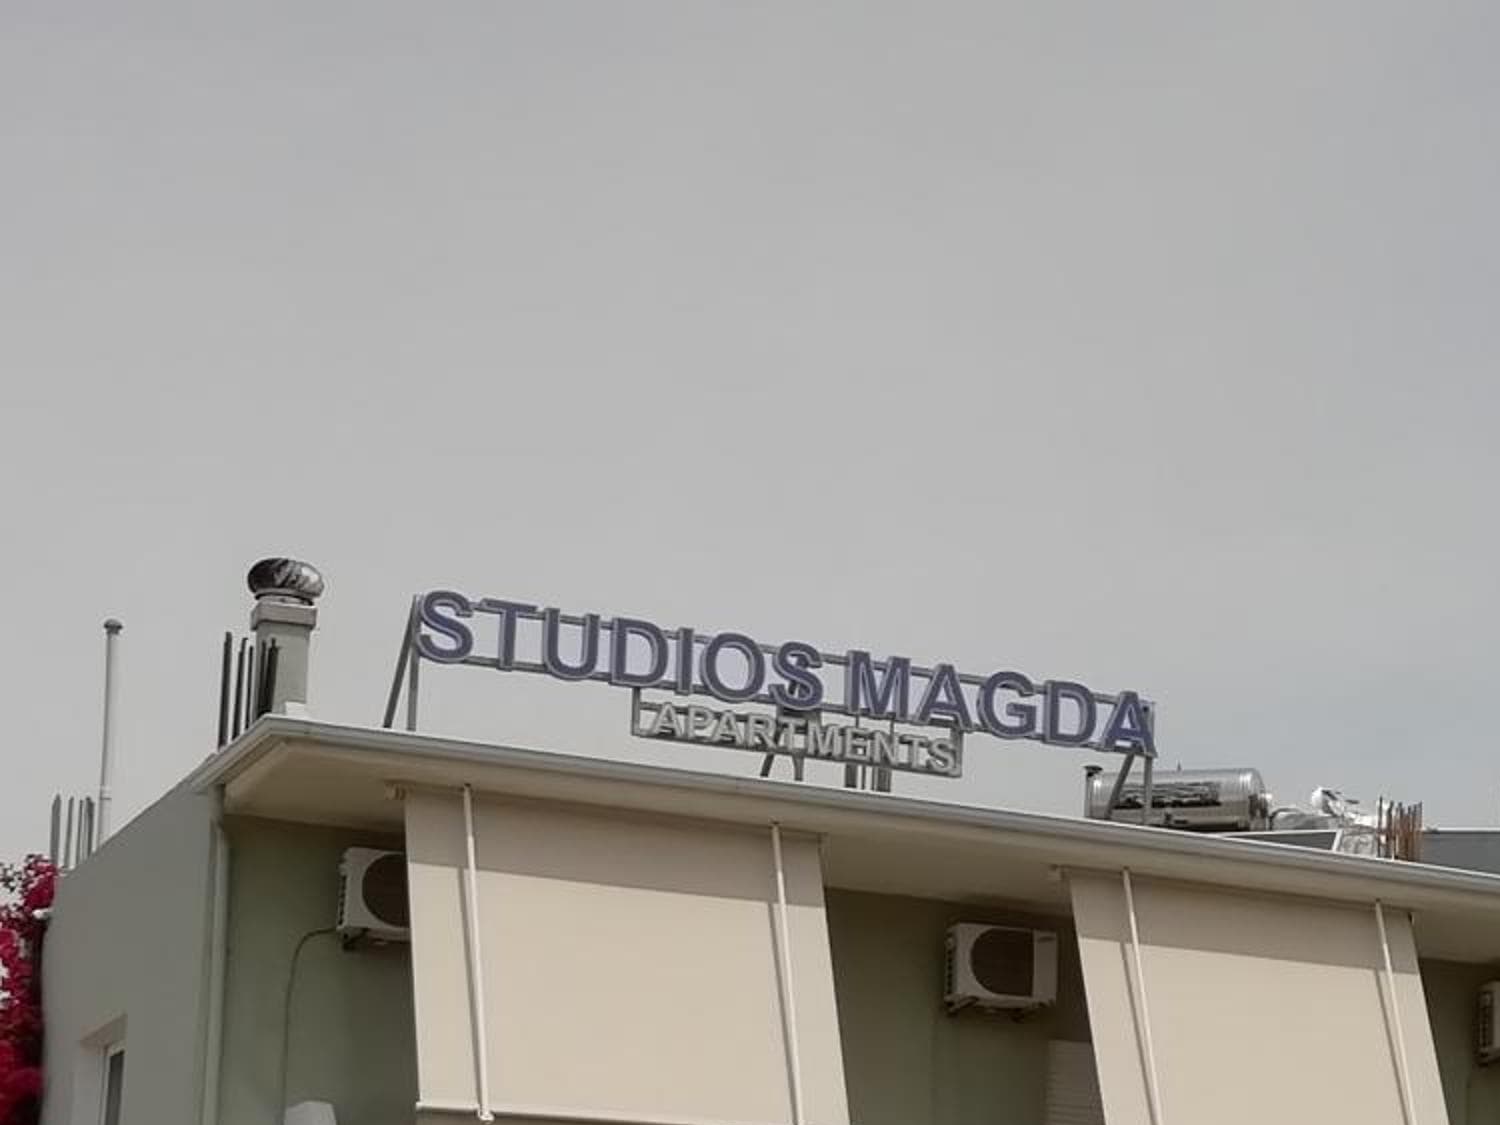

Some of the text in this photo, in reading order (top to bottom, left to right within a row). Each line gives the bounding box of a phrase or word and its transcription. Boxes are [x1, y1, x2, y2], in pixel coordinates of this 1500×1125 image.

[416, 590, 1157, 756] STUDIOS MAGDA
[649, 701, 955, 773] APARTMENTS
